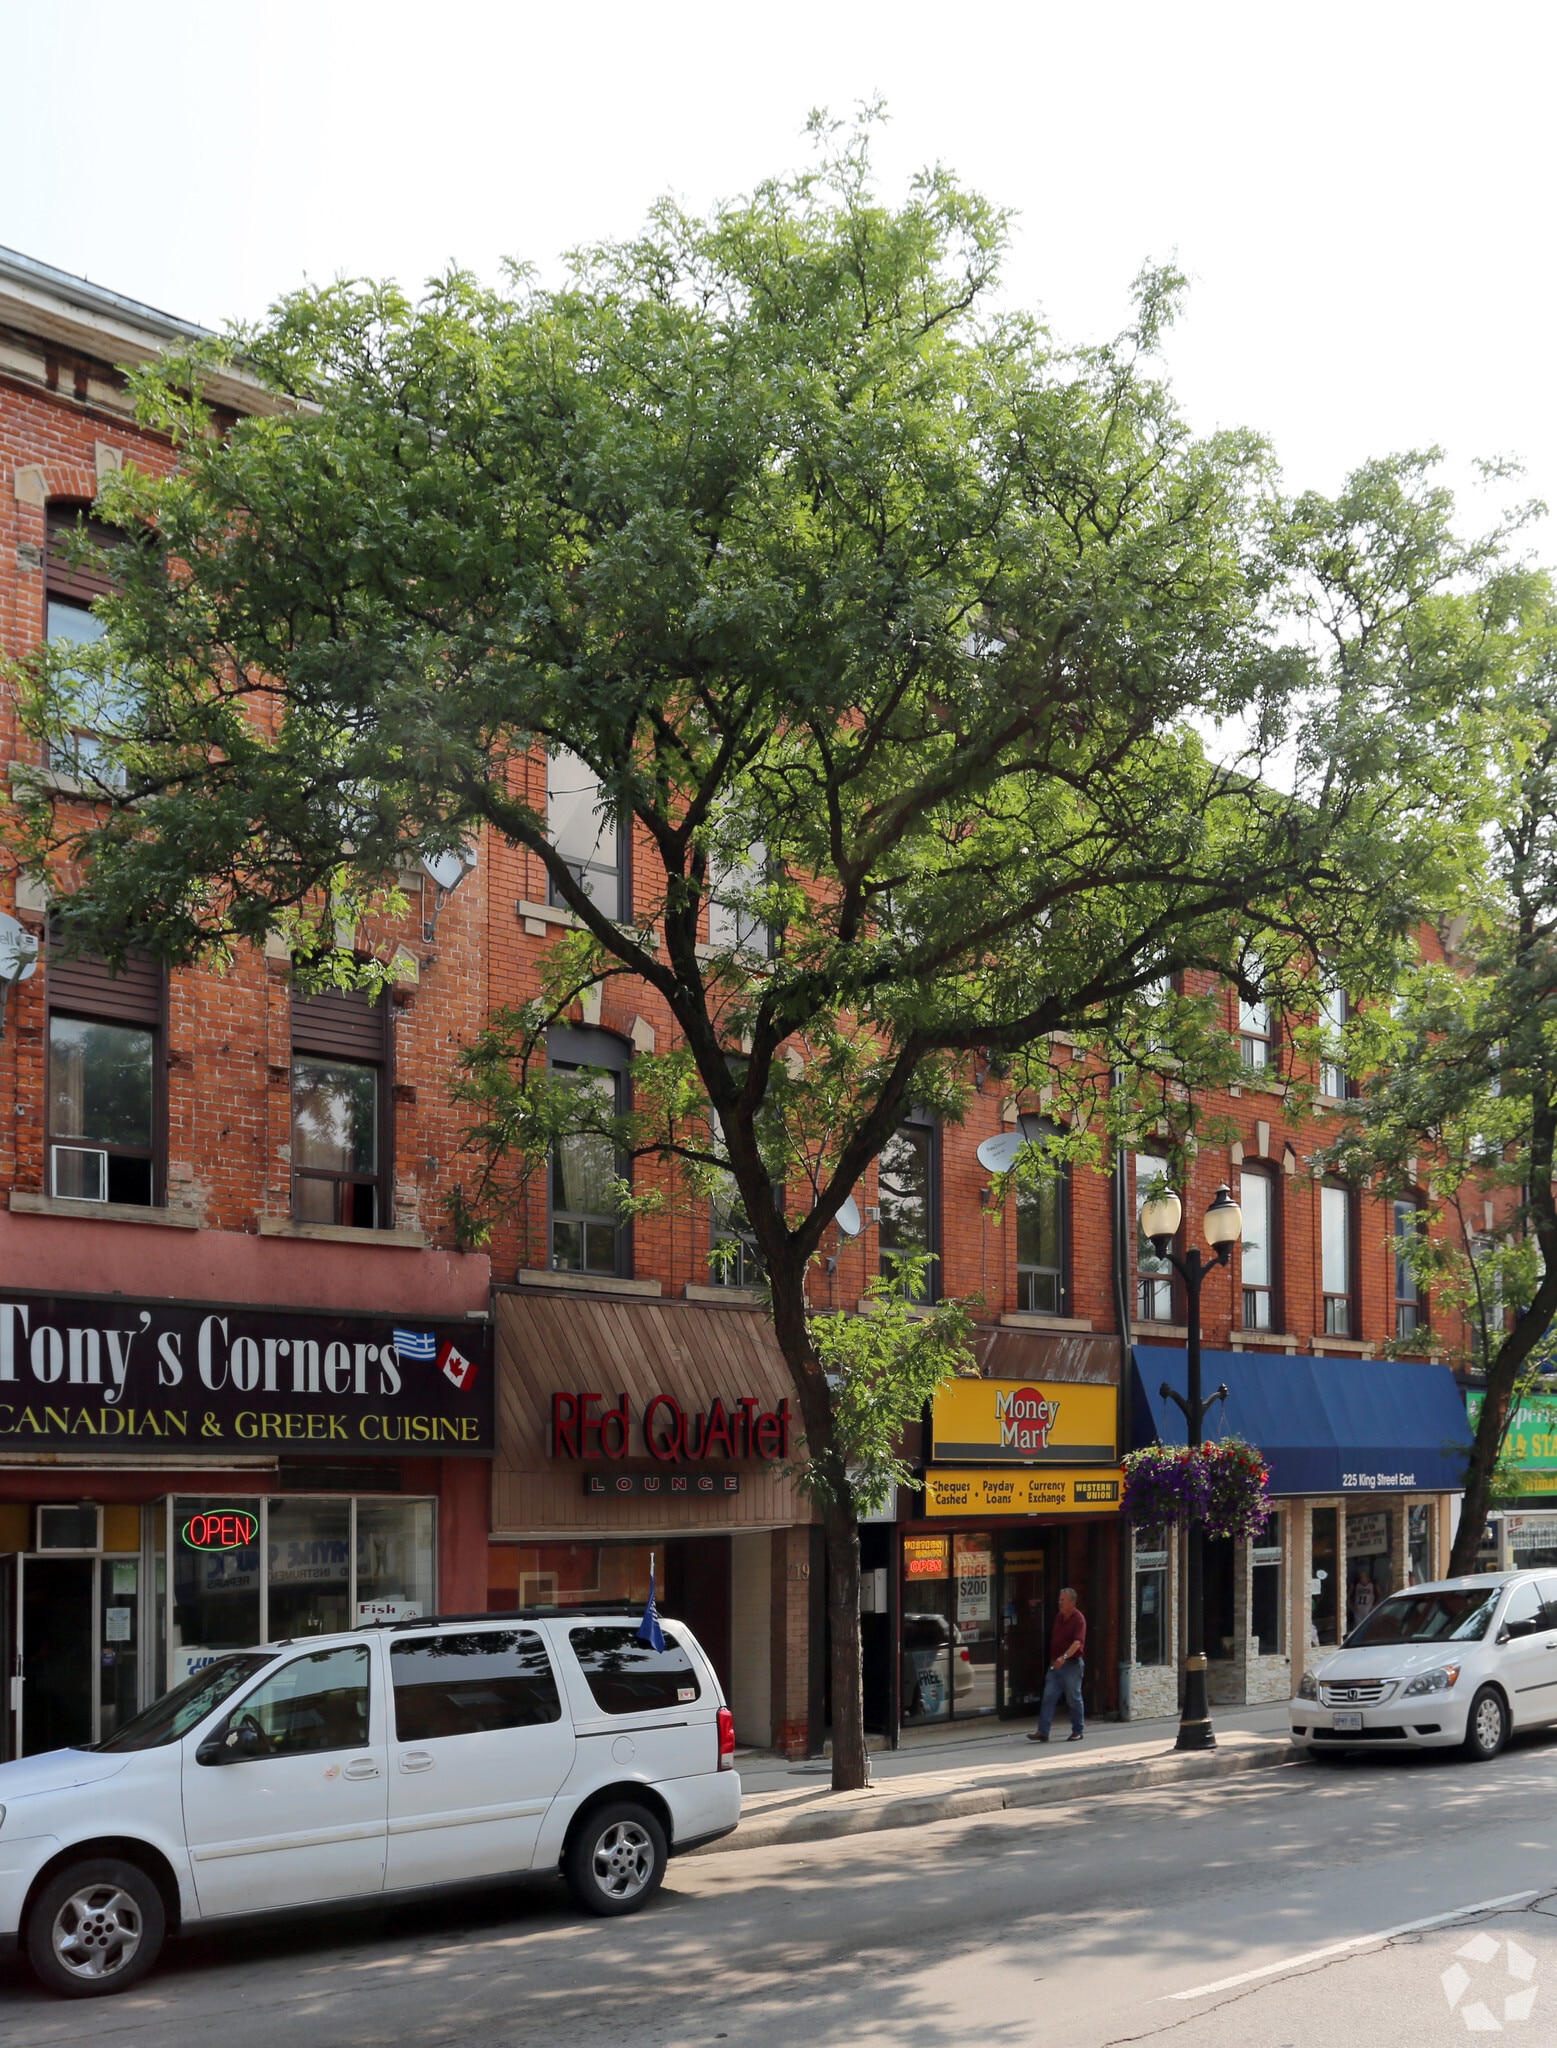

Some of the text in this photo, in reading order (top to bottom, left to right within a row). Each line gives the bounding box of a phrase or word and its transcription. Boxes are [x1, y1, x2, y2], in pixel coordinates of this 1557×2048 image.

[0, 1303, 401, 1404] Tony's Corners
[995, 1390, 1060, 1430] Money
[0, 1404, 480, 1441] CANADIAN & GREEK CUISINE
[1000, 1420, 1050, 1449] Mart
[591, 1477, 738, 1492] LOUNGE
[933, 1480, 970, 1494] Cheques
[983, 1480, 1014, 1493] Payday
[1028, 1480, 1065, 1493] Currency
[1075, 1483, 1112, 1492] WESTERN
[1342, 1473, 1358, 1487] 225
[1358, 1473, 1376, 1489] King
[1376, 1473, 1398, 1486] Street
[935, 1493, 968, 1505] Cashed
[986, 1493, 1011, 1504] Loans
[1028, 1492, 1066, 1506] Exchange
[1086, 1491, 1112, 1500] UNION
[190, 1515, 250, 1546] OPEN
[903, 1540, 942, 1550] WESTERN
[910, 1559, 942, 1573] OPEN
[960, 1564, 988, 1580] FREE
[960, 1580, 988, 1597] $200
[360, 1604, 396, 1614] Fish
[919, 1669, 941, 1686] FREE
